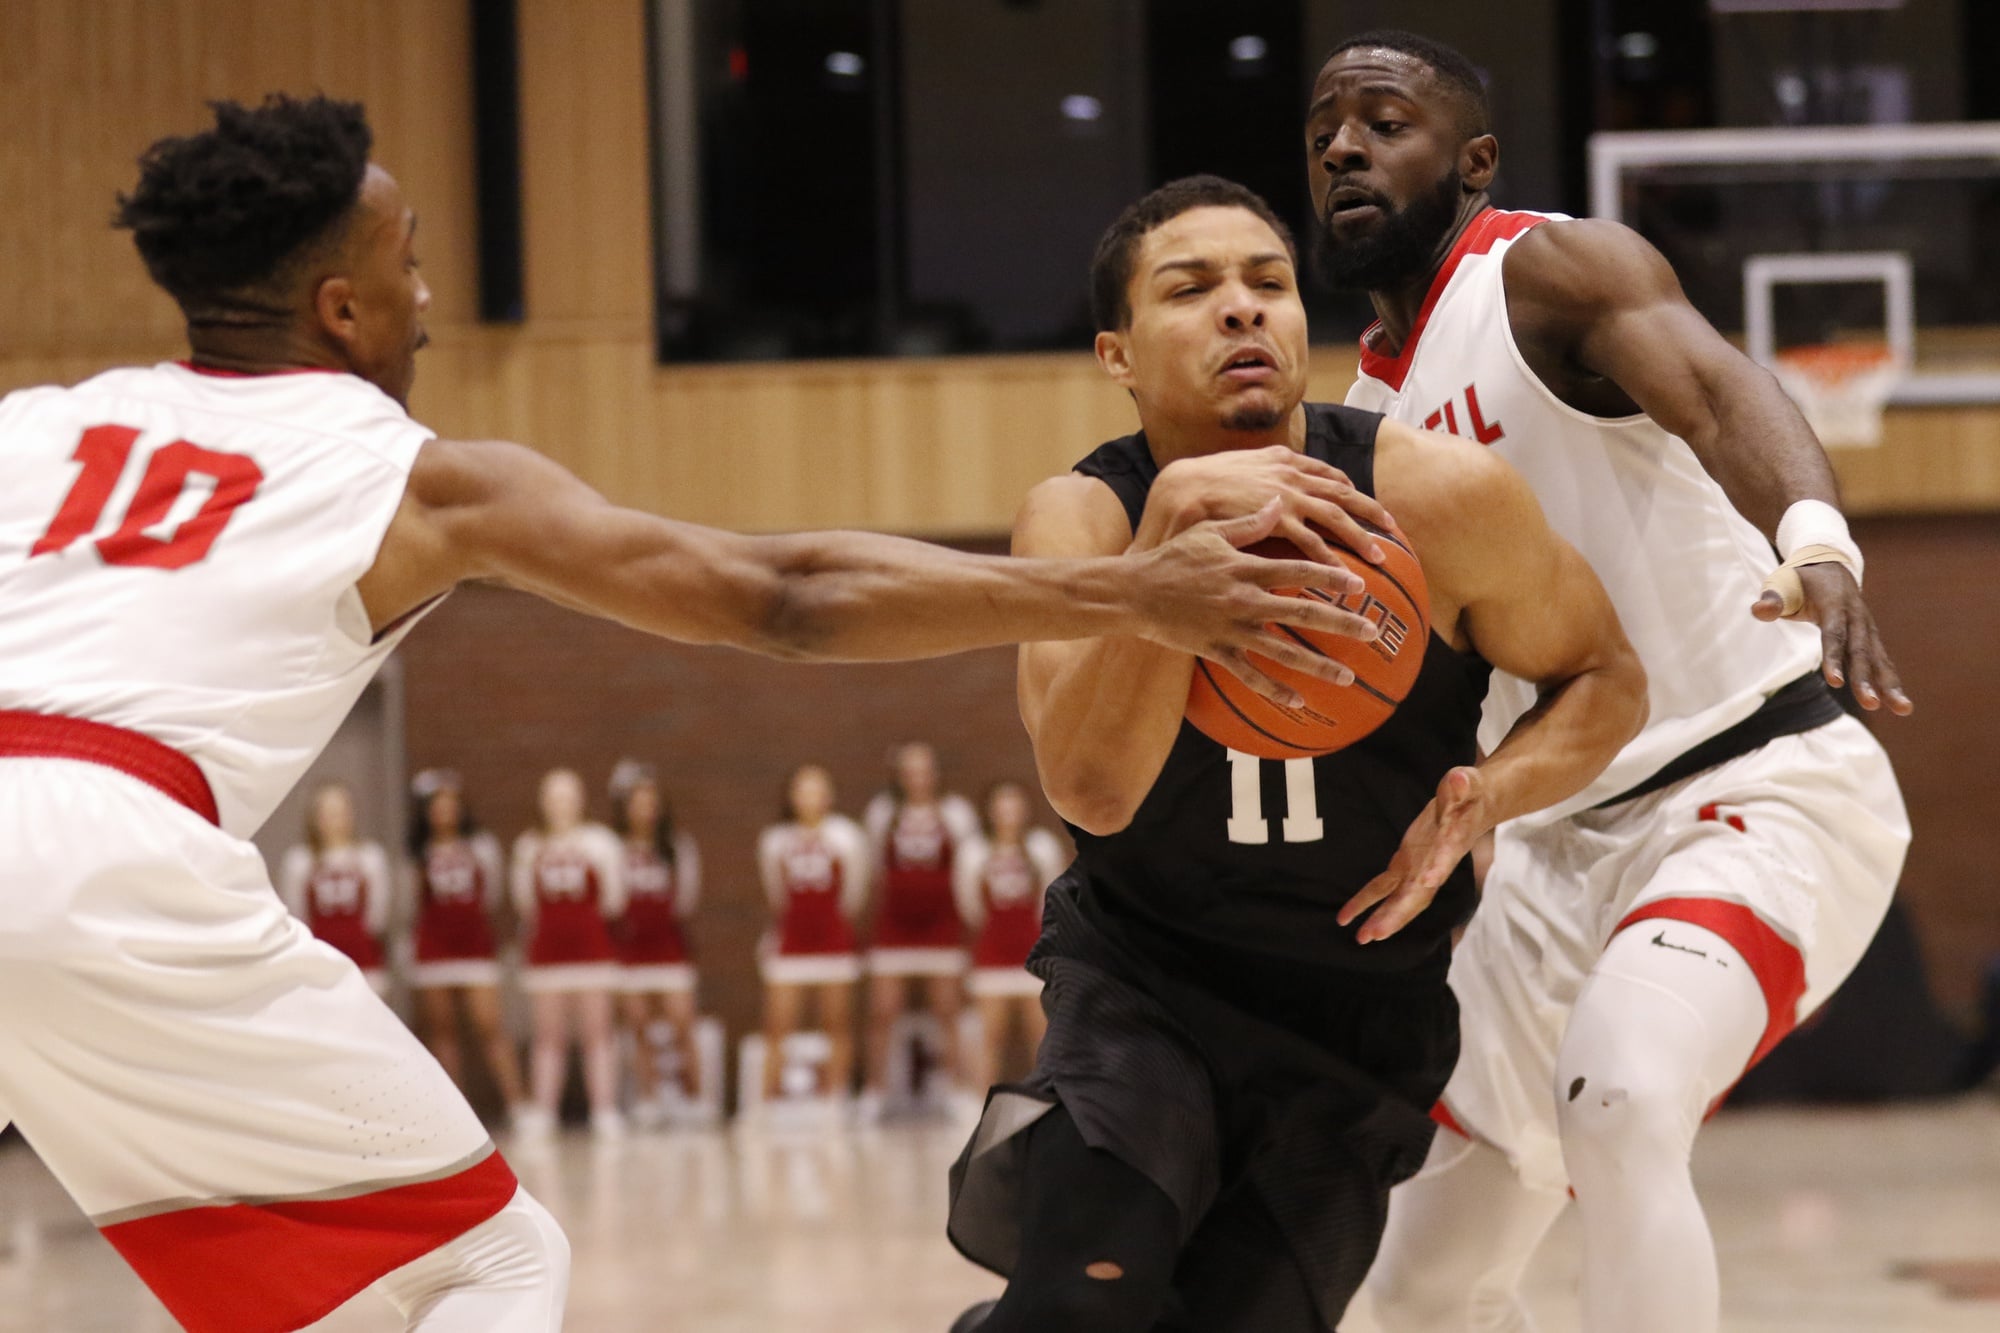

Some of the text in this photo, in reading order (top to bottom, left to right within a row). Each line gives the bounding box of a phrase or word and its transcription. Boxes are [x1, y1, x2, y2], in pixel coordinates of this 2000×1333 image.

[28, 423, 265, 571] 10
[1302, 586, 1409, 657] LITE
[1226, 747, 1324, 845] 11
